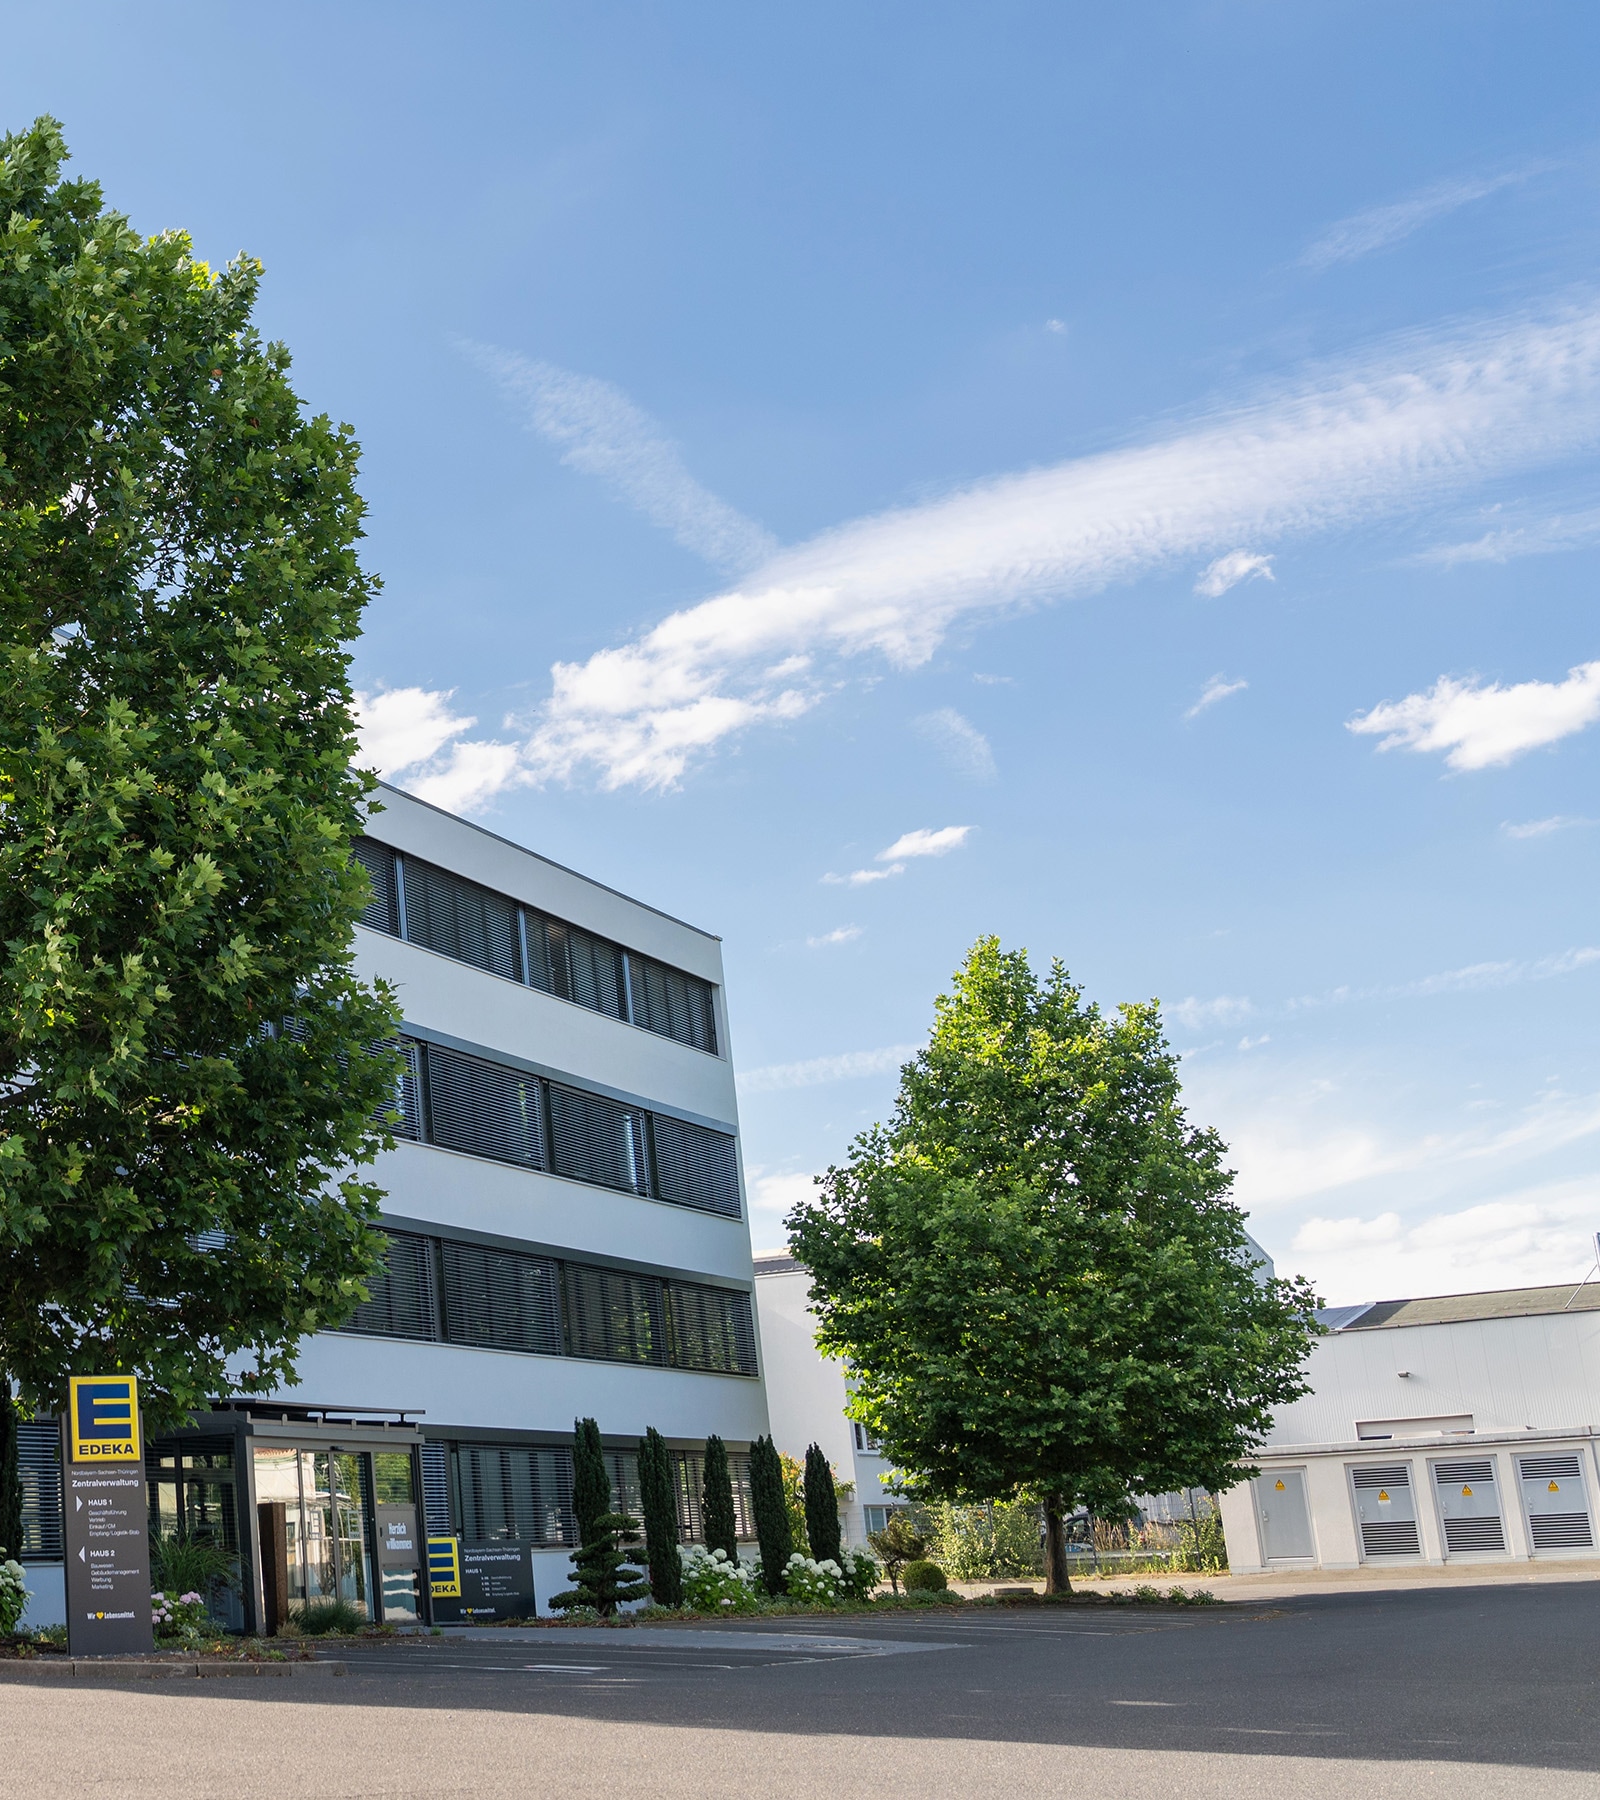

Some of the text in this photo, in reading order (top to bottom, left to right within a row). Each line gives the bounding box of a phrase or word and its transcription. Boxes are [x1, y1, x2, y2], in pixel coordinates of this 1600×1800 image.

[77, 1383, 132, 1439] E
[79, 1443, 134, 1455] EDEKA
[71, 1479, 139, 1488] Zentralverwaltung
[464, 1554, 521, 1562] Zentralverwaltung
